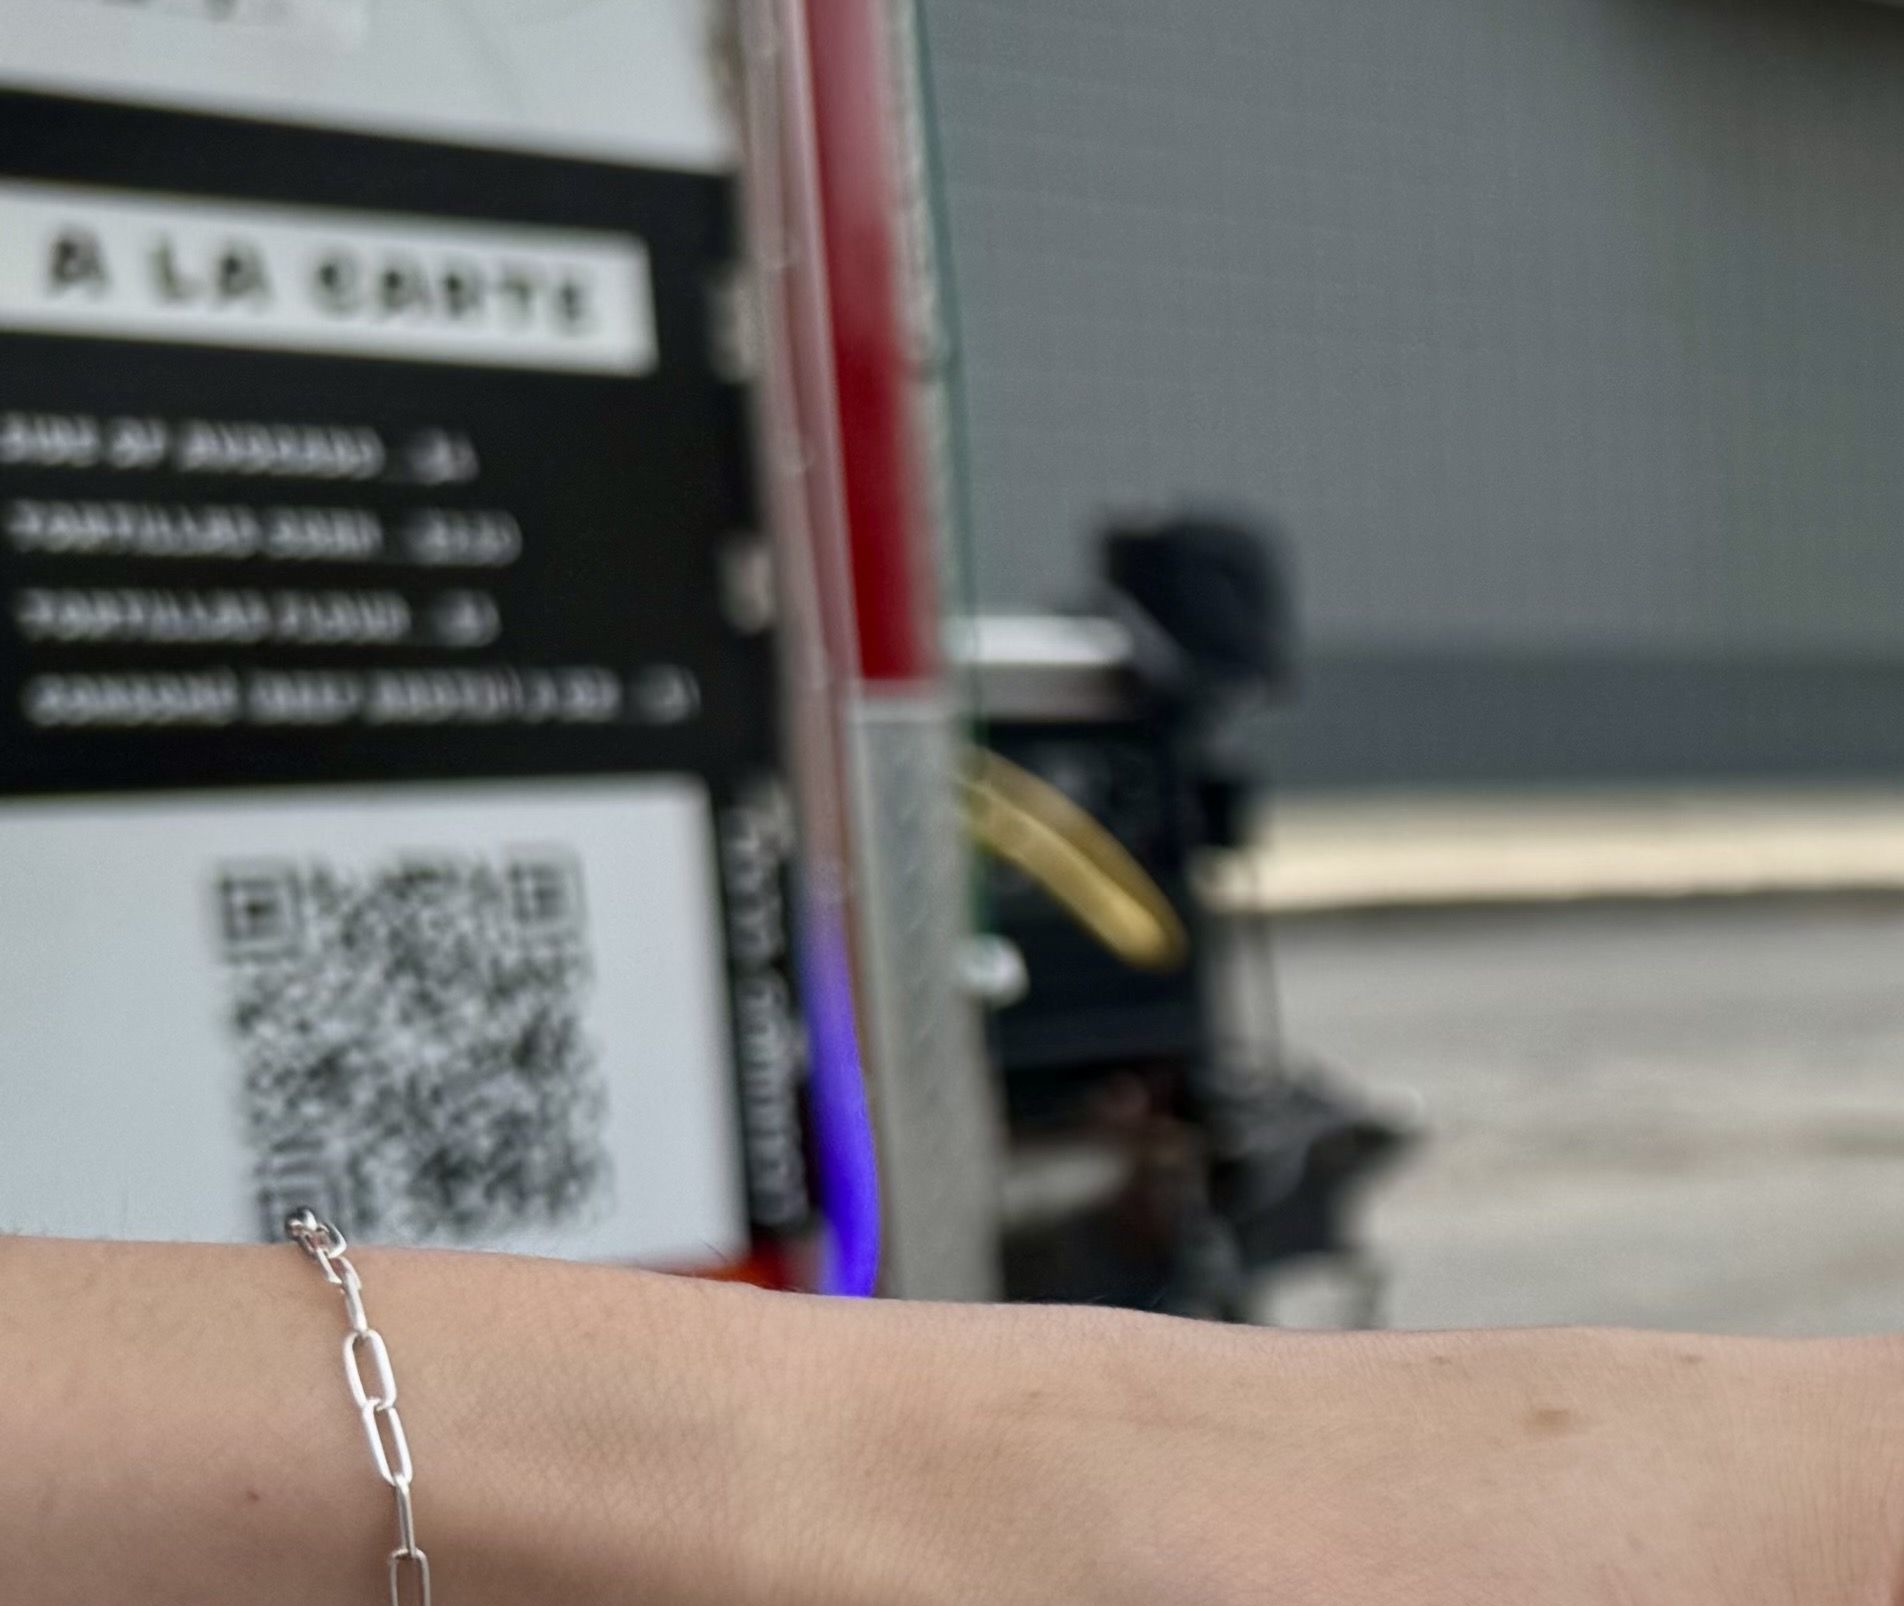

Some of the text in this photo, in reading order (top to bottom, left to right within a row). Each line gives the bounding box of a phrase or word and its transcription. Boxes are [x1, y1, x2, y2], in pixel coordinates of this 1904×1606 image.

[46, 222, 596, 332] A LA CARTE
